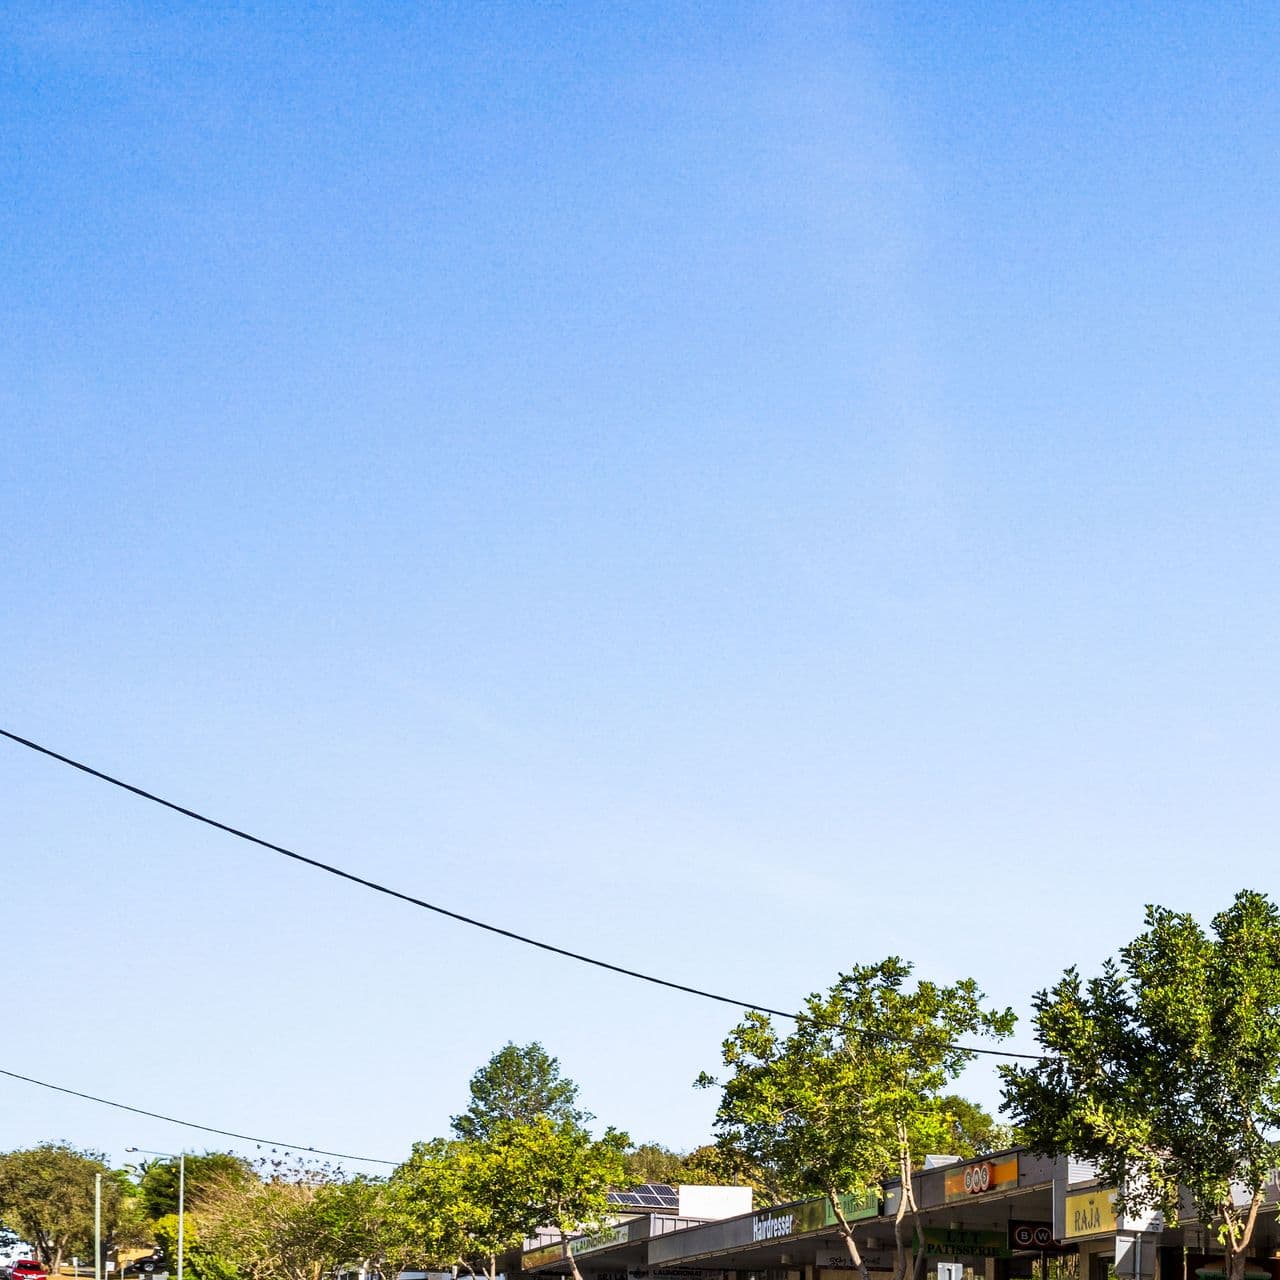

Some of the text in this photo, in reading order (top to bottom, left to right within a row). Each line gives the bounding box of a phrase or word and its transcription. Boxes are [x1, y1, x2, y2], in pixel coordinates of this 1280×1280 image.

[964, 1165, 989, 1190] BWS
[753, 1213, 793, 1241] Hairdresser
[1074, 1209, 1101, 1232] RAJA
[927, 1243, 999, 1256] PATISSERIE
